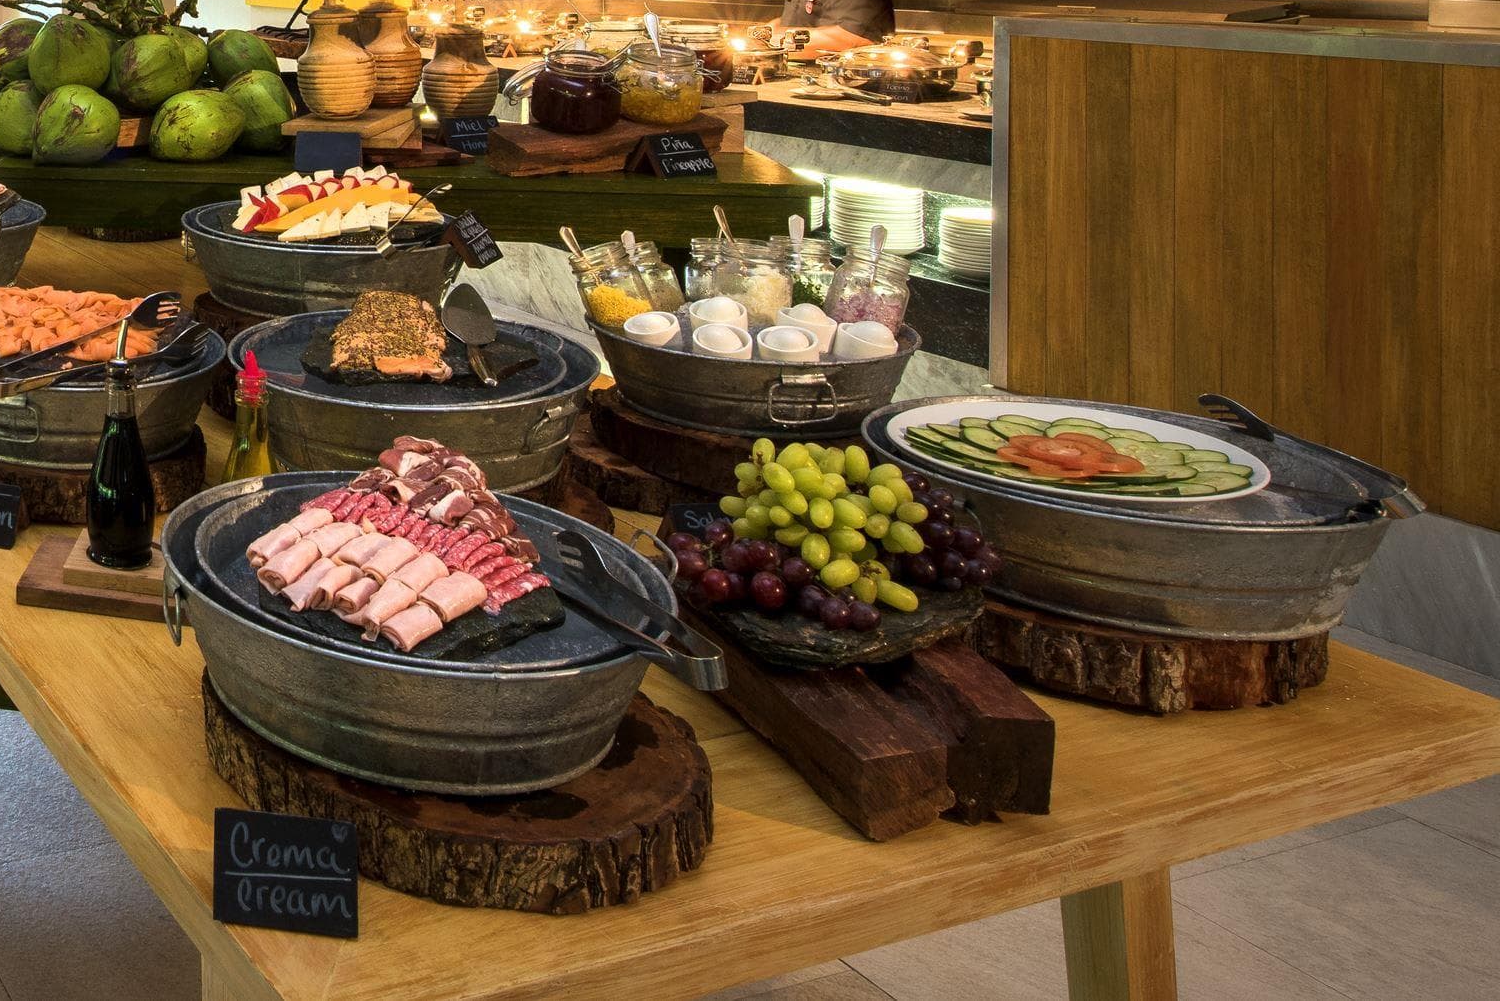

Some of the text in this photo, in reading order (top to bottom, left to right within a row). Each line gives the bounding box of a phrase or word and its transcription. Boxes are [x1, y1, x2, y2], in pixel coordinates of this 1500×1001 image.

[455, 120, 486, 132] Miel
[662, 158, 714, 173] Pineapple
[230, 821, 351, 874] Crema
[237, 877, 352, 918] Cream
